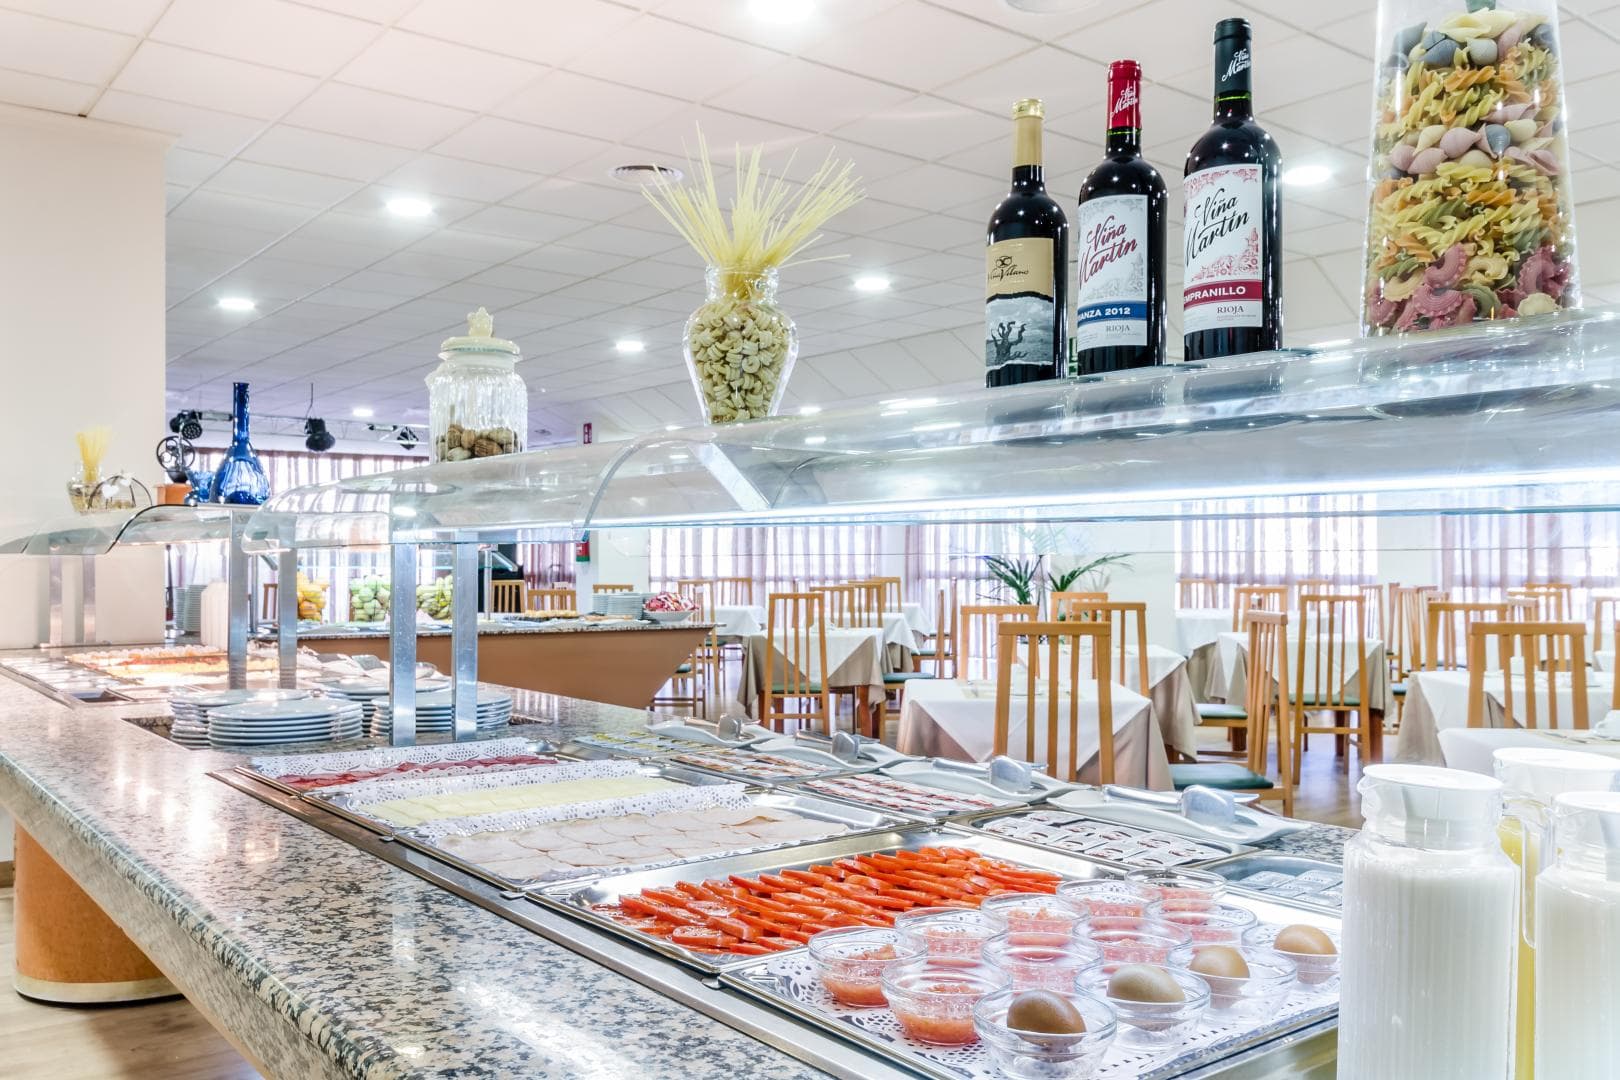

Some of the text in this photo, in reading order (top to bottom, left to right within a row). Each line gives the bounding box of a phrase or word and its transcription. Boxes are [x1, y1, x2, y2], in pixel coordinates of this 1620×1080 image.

[1194, 187, 1238, 226] Viña
[1087, 215, 1127, 252] Viña
[1104, 307, 1131, 316] 2012
[1217, 305, 1244, 314] RIOJA
[1106, 325, 1130, 333] RIOJA
